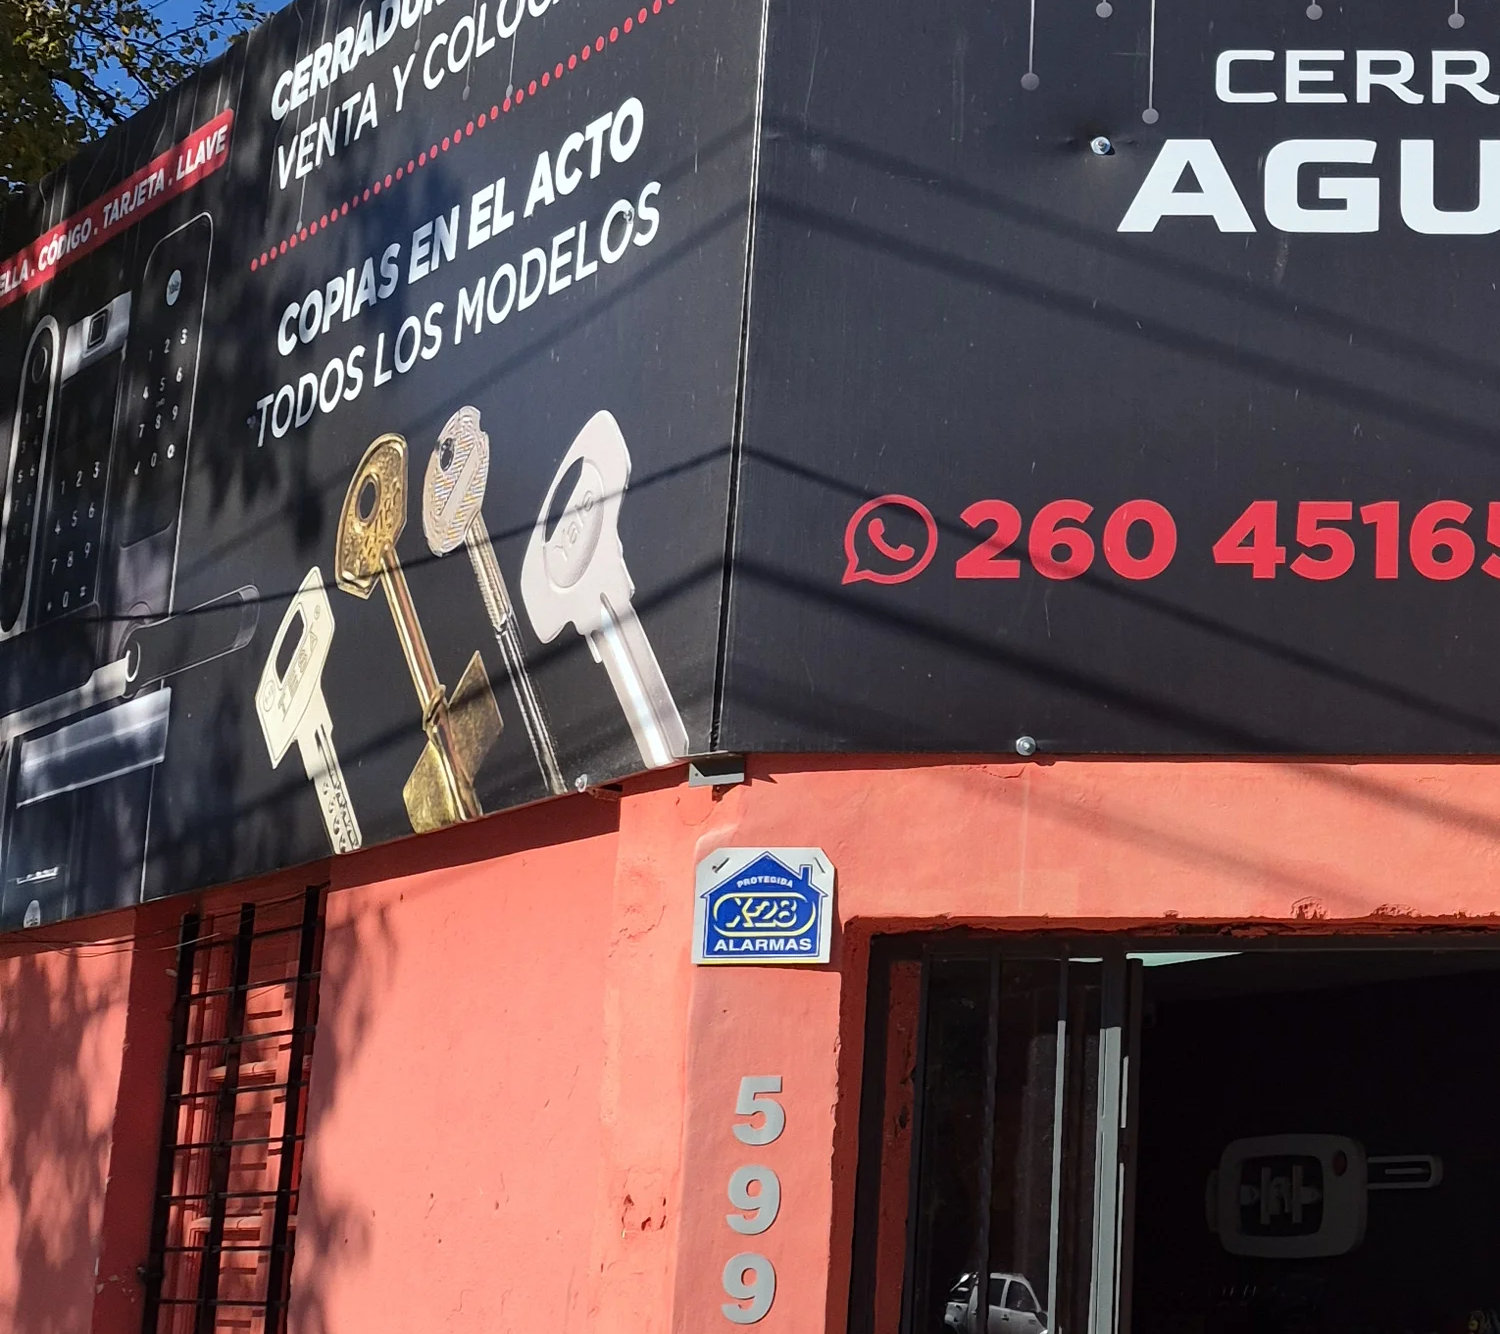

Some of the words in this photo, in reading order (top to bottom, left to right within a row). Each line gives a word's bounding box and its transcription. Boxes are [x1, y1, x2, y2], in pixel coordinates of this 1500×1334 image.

[277, 91, 379, 190] VENTA
[391, 55, 415, 113] Y
[38, 217, 91, 272] CÓDIGO
[102, 168, 164, 228] TARJETA
[176, 123, 228, 181] LLAVE
[277, 242, 400, 358] COPIAS
[409, 206, 459, 285] EN
[467, 181, 514, 250] EL
[525, 97, 644, 215] ACTO
[255, 345, 365, 447] TODOS
[374, 301, 441, 385] LOS
[453, 181, 660, 345] MODELOS
[956, 498, 1177, 582] 260
[714, 938, 812, 952] ALARMAS
[736, 875, 793, 888] PROTEGIDA
